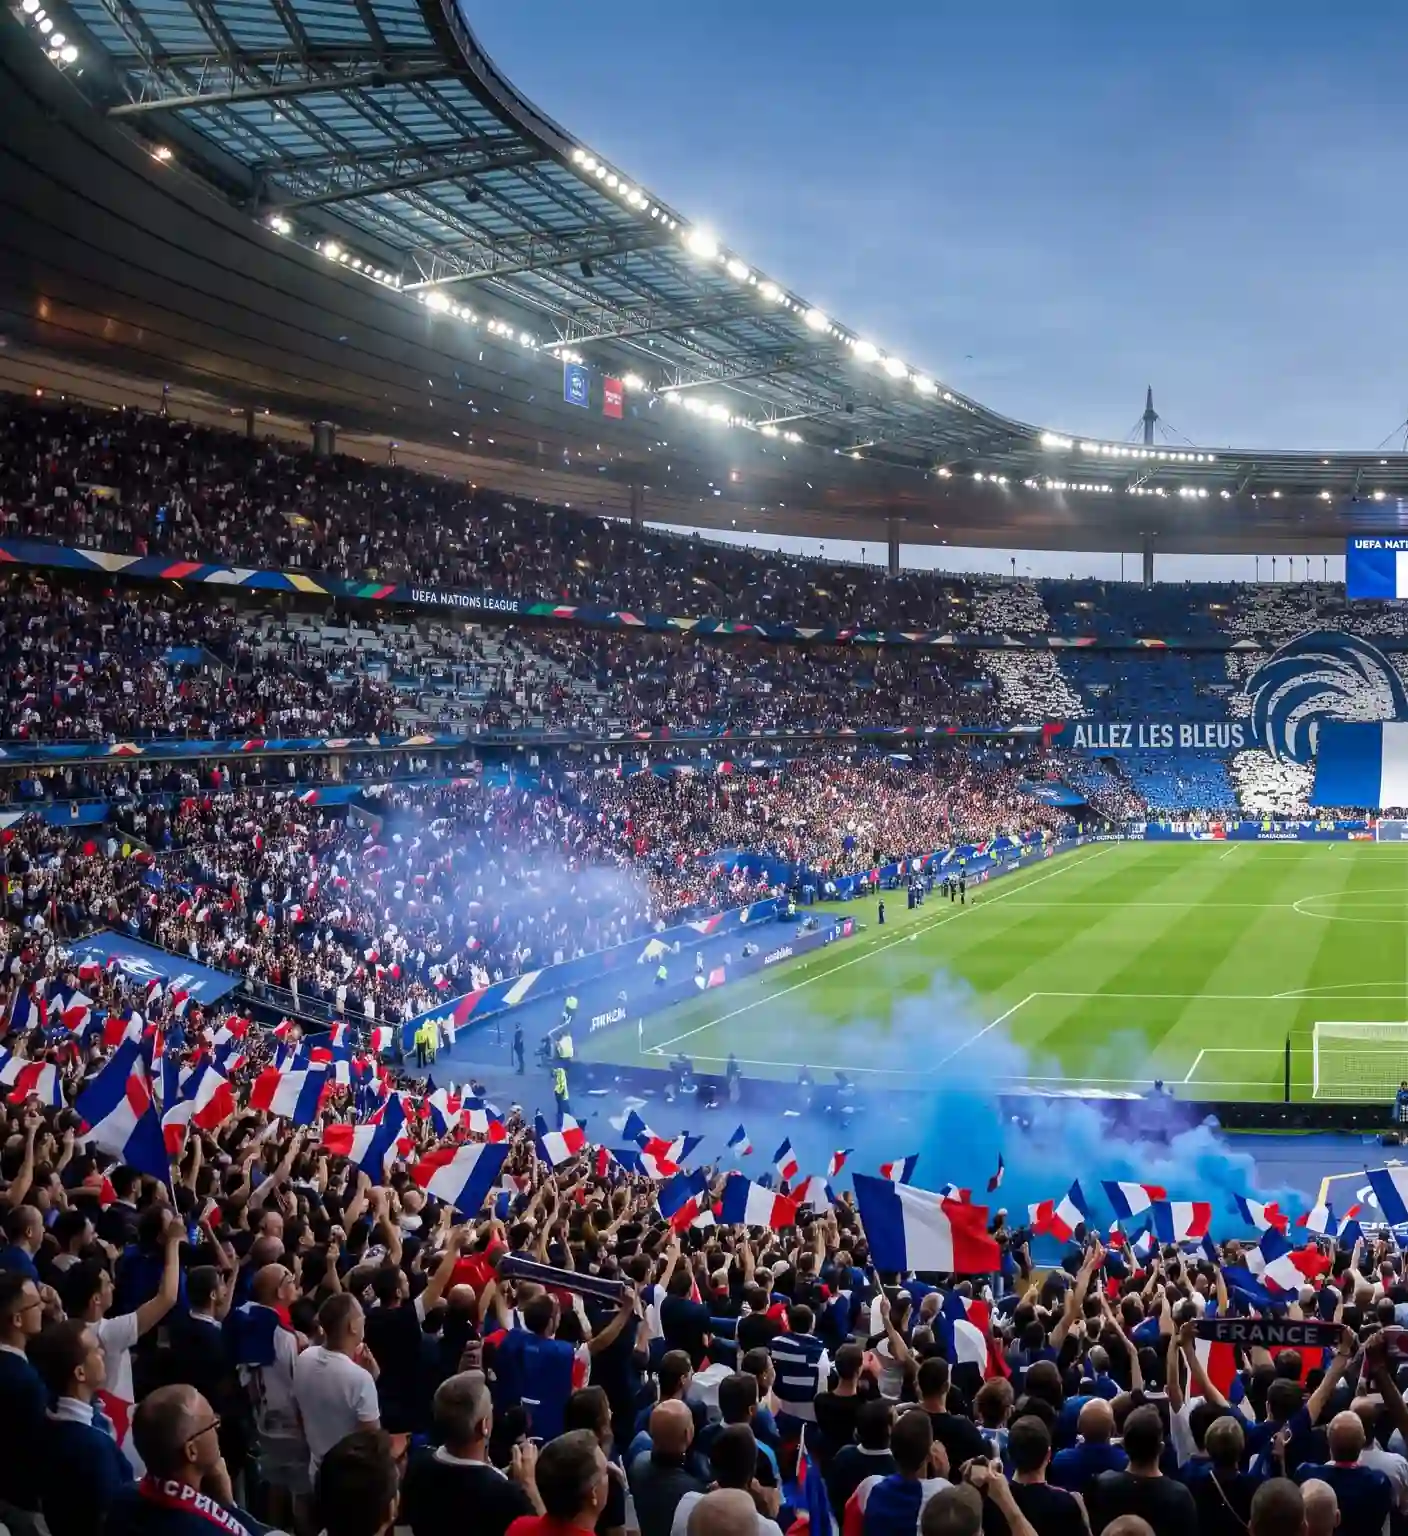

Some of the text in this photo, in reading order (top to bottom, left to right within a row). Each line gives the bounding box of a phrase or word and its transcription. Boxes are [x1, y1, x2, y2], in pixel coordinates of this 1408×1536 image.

[1354, 539, 1382, 549] UEFA
[411, 588, 519, 612] UEFA NATIONS LEAGUE
[1073, 723, 1245, 748] ALLEZ LES BLEUS
[1216, 1323, 1318, 1344] FRANCE
